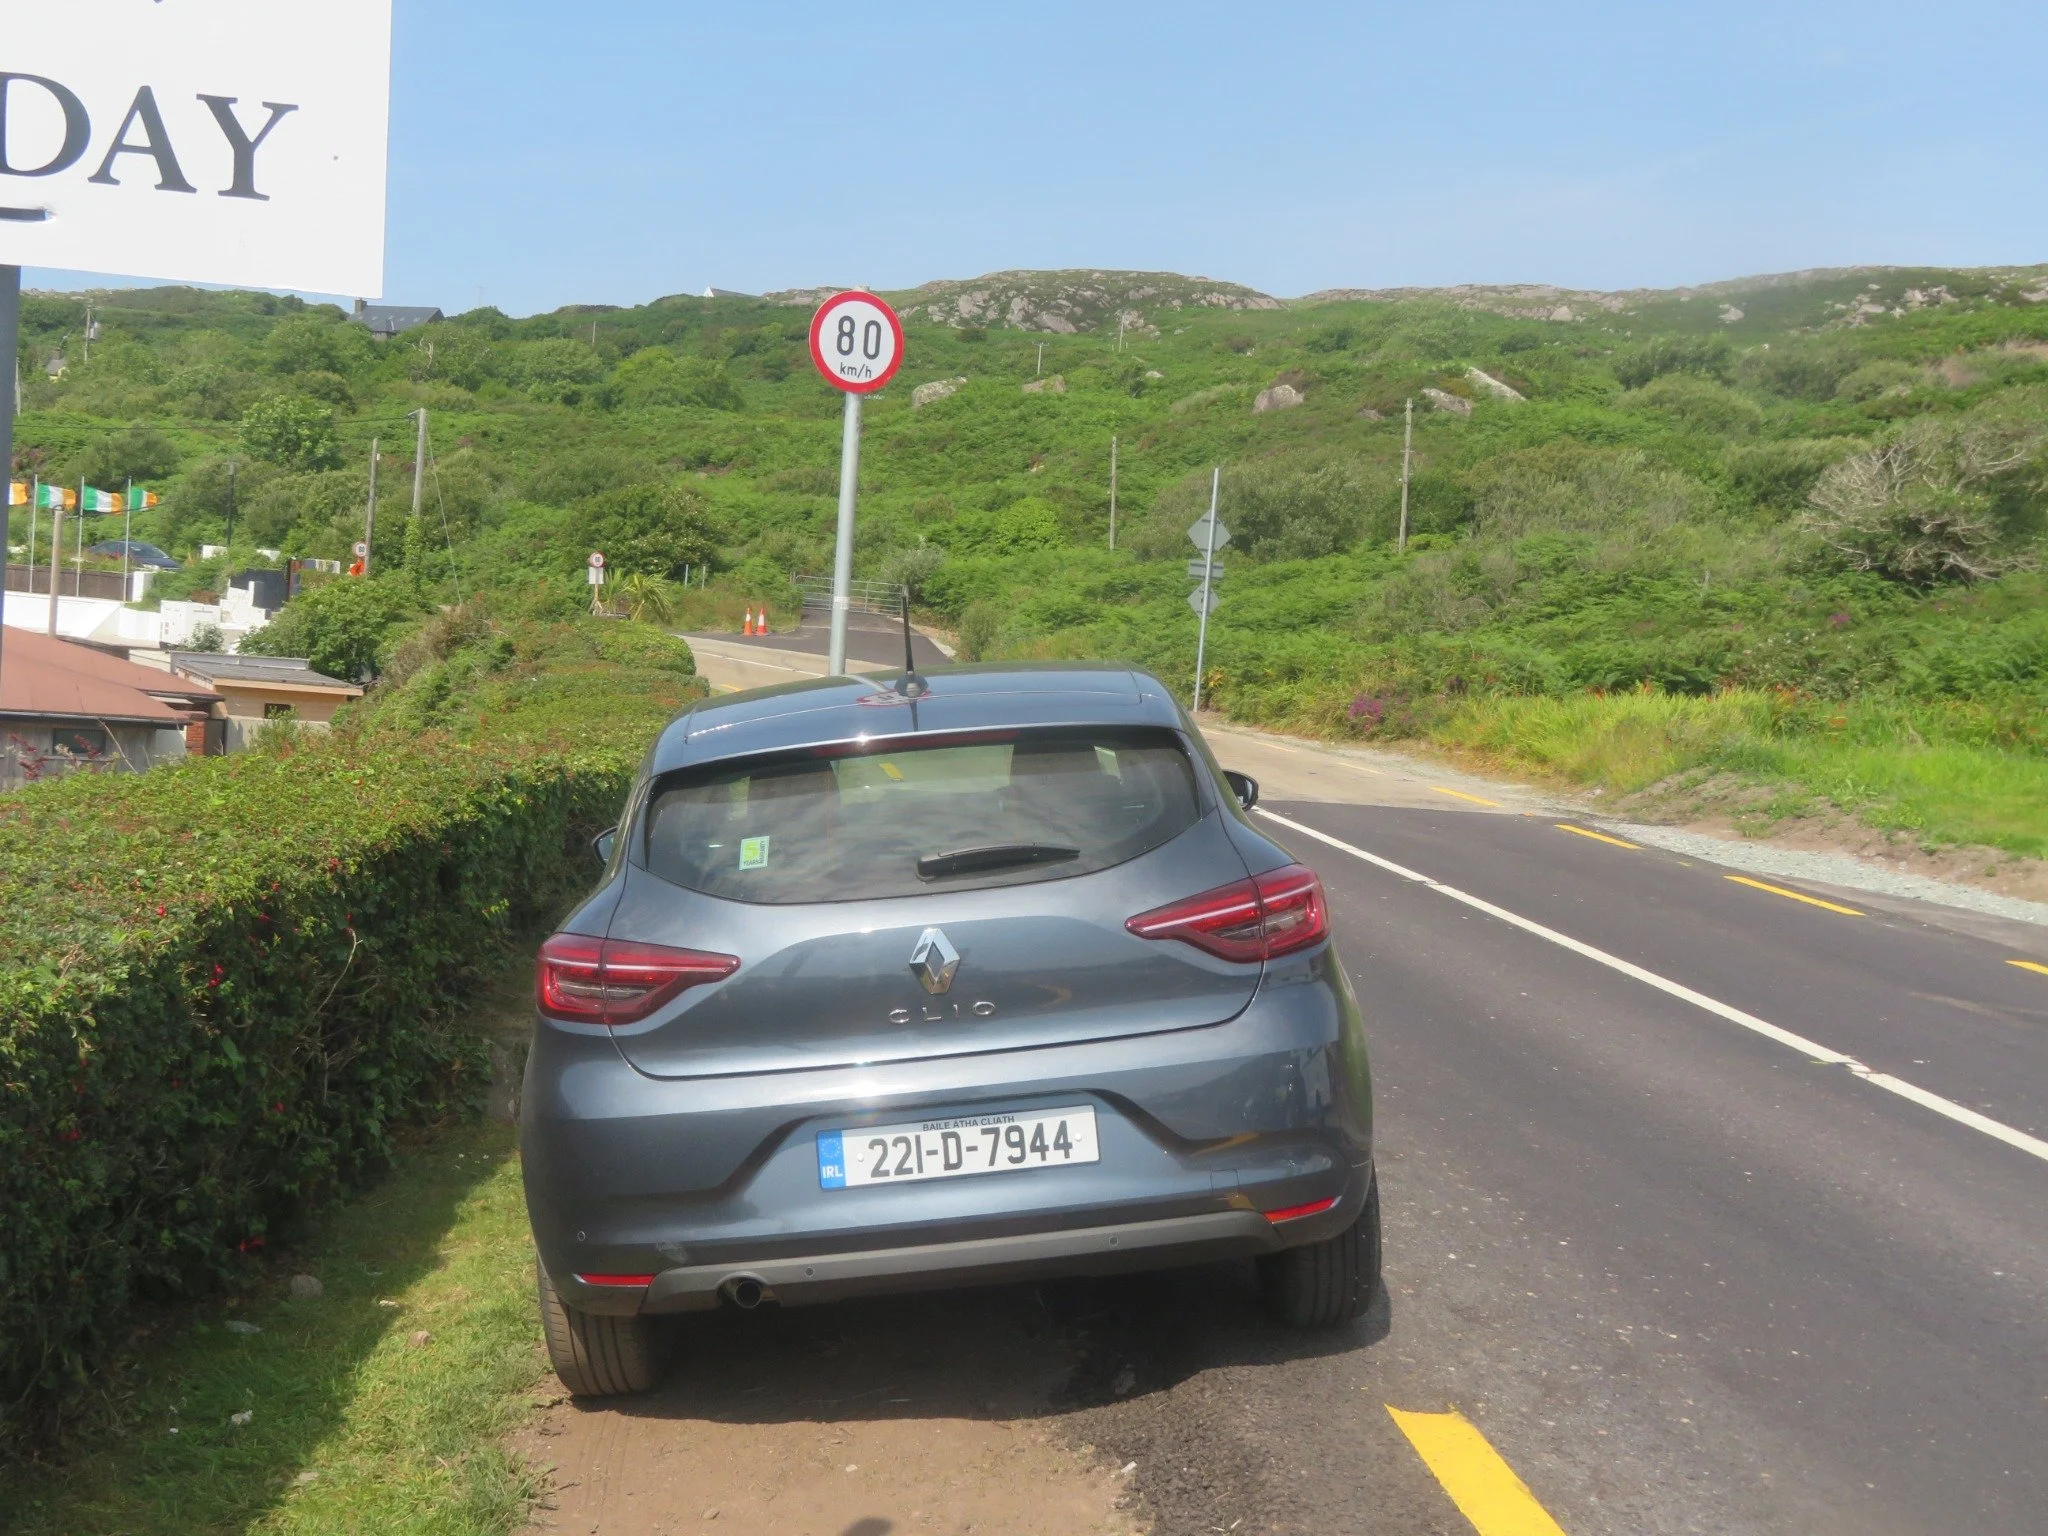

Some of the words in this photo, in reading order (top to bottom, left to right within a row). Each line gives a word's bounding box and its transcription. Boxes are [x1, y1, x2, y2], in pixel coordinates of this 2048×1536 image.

[0, 71, 299, 201] DAY
[837, 315, 881, 360] 80
[840, 362, 872, 378] km/h
[743, 859, 760, 867] YEARS
[888, 1001, 995, 1024] CLIO
[923, 1121, 950, 1132] BAILE
[980, 1115, 1015, 1127] CLIATH
[868, 1120, 1073, 1178] 221-D-7944
[822, 1165, 843, 1178] IRL
